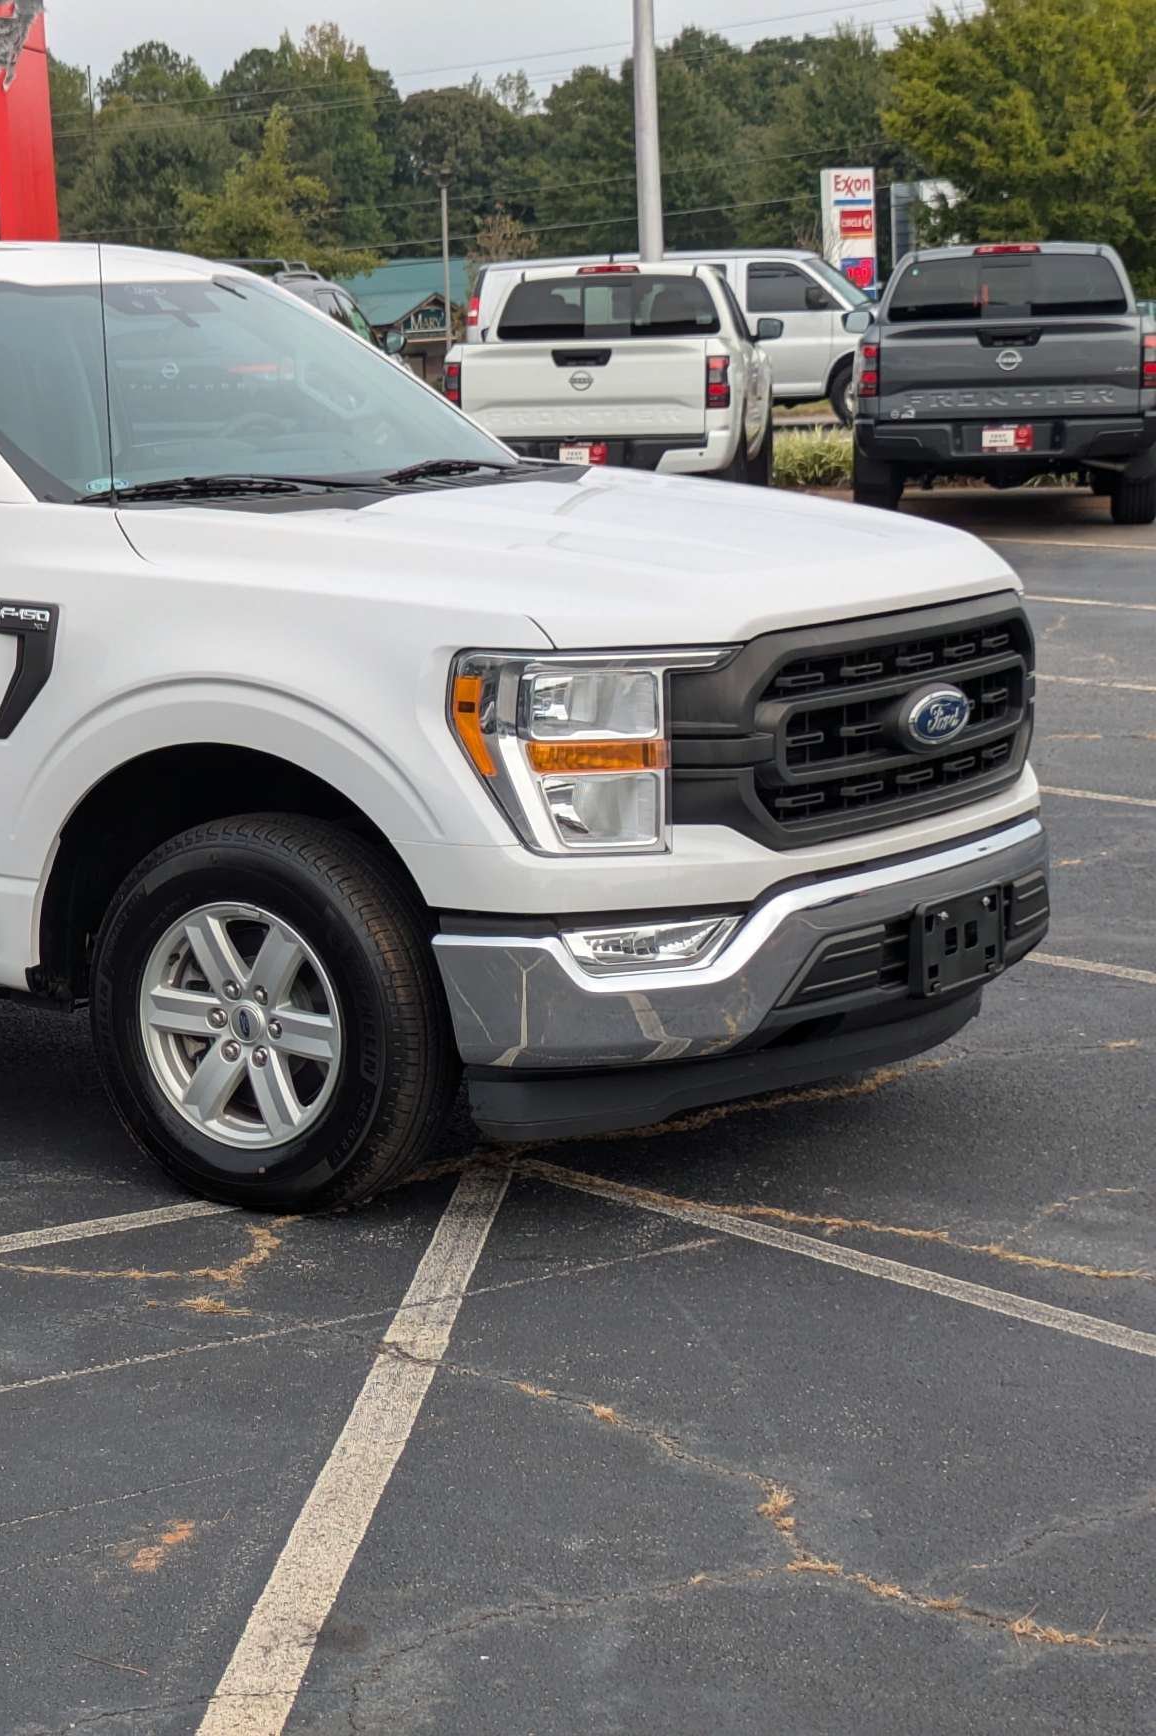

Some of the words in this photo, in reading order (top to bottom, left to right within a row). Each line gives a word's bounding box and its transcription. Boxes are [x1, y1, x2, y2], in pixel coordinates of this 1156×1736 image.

[833, 174, 871, 198] Exxon
[905, 386, 1116, 408] FRONTIER
[485, 407, 681, 426] FRONTIER
[0, 606, 50, 623] F-150
[34, 622, 48, 631] XL
[926, 702, 960, 733] Ford
